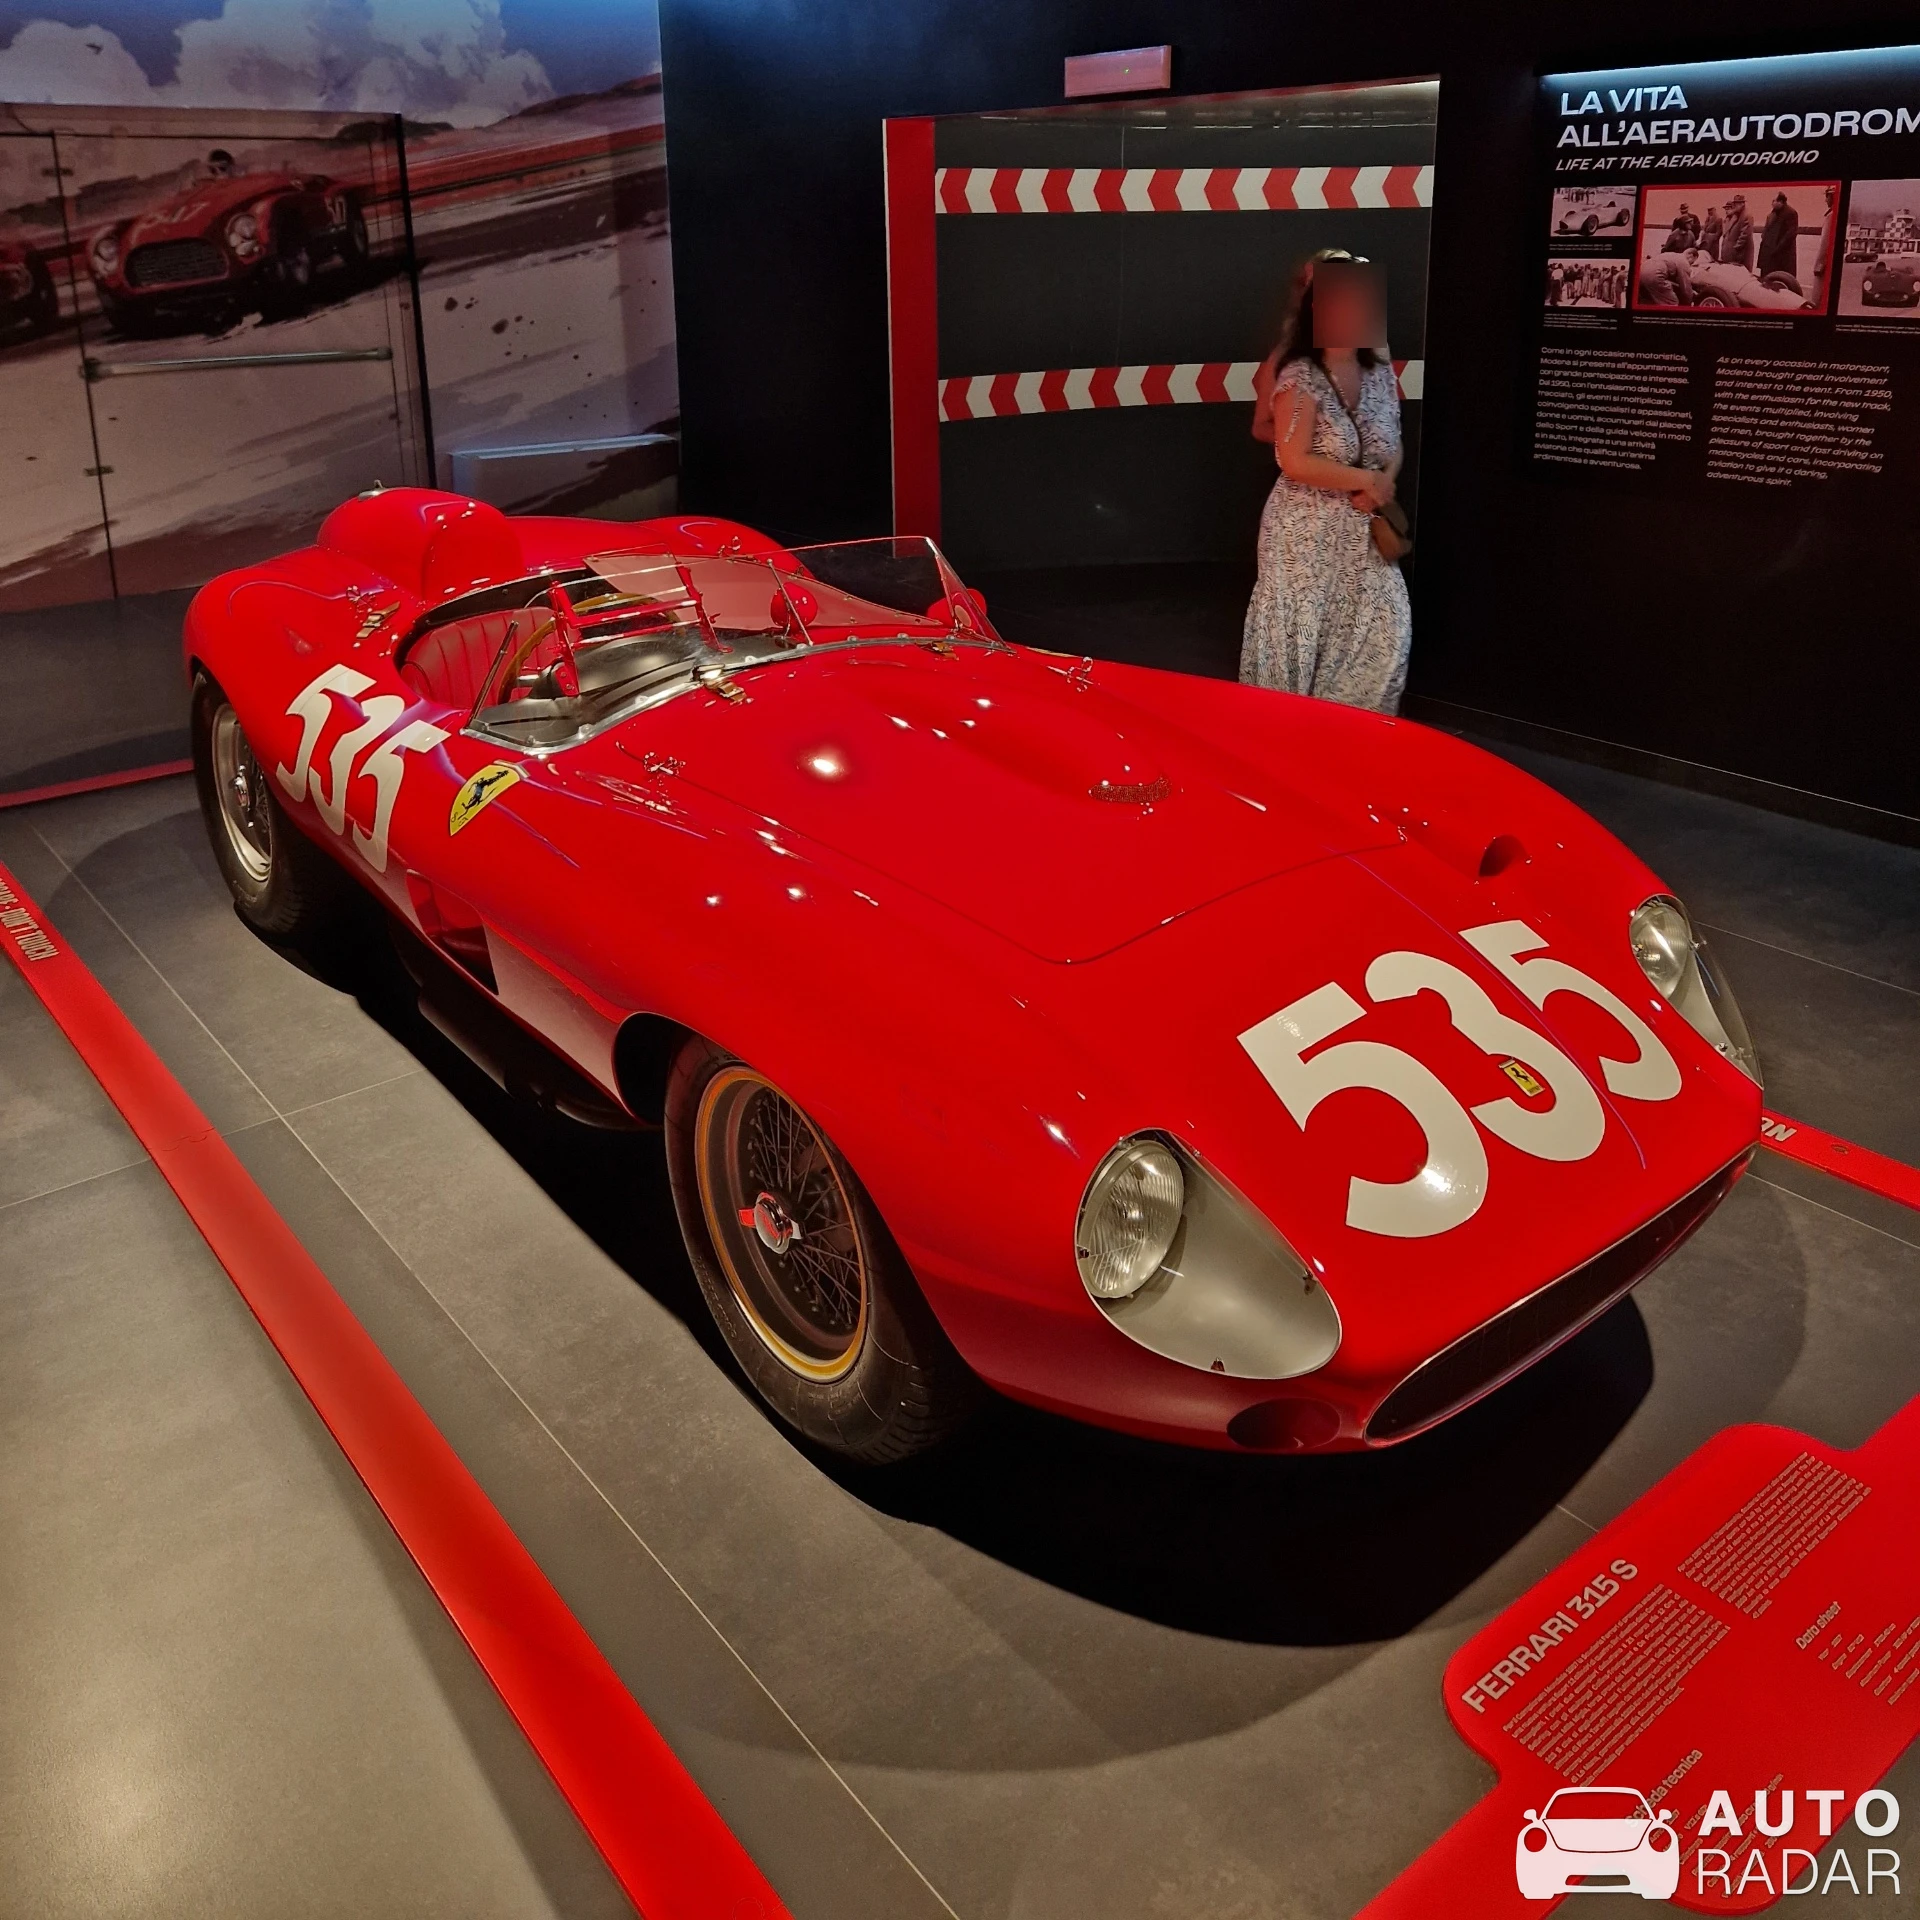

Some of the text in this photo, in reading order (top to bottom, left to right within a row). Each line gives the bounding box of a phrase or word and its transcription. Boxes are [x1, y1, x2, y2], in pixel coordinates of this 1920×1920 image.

[1561, 85, 1689, 116] LA VITA
[1555, 150, 1820, 172] LIFE AT THE AERAUTODROMO
[1541, 346, 1565, 355] Come
[1573, 349, 1592, 357] ogni
[1592, 350, 1636, 359] occasione
[1540, 357, 1572, 366] Modena
[1579, 361, 1616, 369] presenta
[1716, 356, 1730, 364] As
[1744, 358, 1772, 367] every
[1772, 360, 1817, 368] occasion
[1817, 361, 1828, 369] in
[1716, 368, 1888, 385] Modena brought great involvement
[1575, 392, 1586, 400] gli
[1637, 385, 1650, 393] del
[1649, 387, 1676, 395] nuovo
[1734, 380, 1773, 390] interest
[1773, 383, 1784, 391] to
[1785, 384, 1802, 392] the
[1834, 387, 1863, 396] From
[1714, 391, 1734, 399] with
[1734, 392, 1750, 400] the
[1750, 394, 1805, 404] enthusiasm
[1804, 397, 1822, 405] for
[1821, 399, 1838, 407] the
[1590, 405, 1630, 414] specialisti
[1713, 402, 1729, 410] the
[1729, 405, 1761, 413] events
[1813, 409, 1859, 423] involving
[1536, 411, 1561, 419] donne
[1659, 421, 1692, 430] piacere
[1711, 415, 1759, 425] specialists
[1837, 425, 1875, 434] women
[1535, 421, 1555, 429] dello
[1555, 423, 1578, 431] Sport
[1585, 426, 1605, 434] della
[1605, 428, 1629, 436] guida
[1629, 430, 1658, 438] veloce
[1658, 431, 1667, 439] in
[1667, 433, 1692, 442] moto
[1710, 426, 1730, 434] and
[1754, 429, 1795, 440] brought
[1795, 433, 1840, 443] together
[1840, 436, 1854, 446] by
[1854, 438, 1872, 446] the
[1567, 445, 1583, 453] che
[1708, 437, 1751, 447] pleasure
[1751, 441, 1763, 449] of
[1762, 442, 1790, 451] sport
[1790, 445, 1811, 453] and
[1809, 445, 1832, 454] fast
[1832, 448, 1869, 460] driving
[1707, 460, 1744, 469] aviation
[1744, 463, 1755, 471] to
[1755, 464, 1776, 473] give
[1708, 449, 1765, 460] motorcycles
[1812, 458, 1882, 473] incorporating
[1706, 471, 1765, 483] adventurous
[276, 663, 452, 873] 535
[0, 907, 39, 935] DON'T
[15, 929, 60, 961] TOUCH
[1236, 920, 1682, 1238] 535
[1795, 1625, 1820, 1650] Data
[1816, 1601, 1841, 1628] sheet
[1461, 1559, 1638, 1713] FERRARI 315 S
[1661, 1749, 1703, 1788] tecnica
